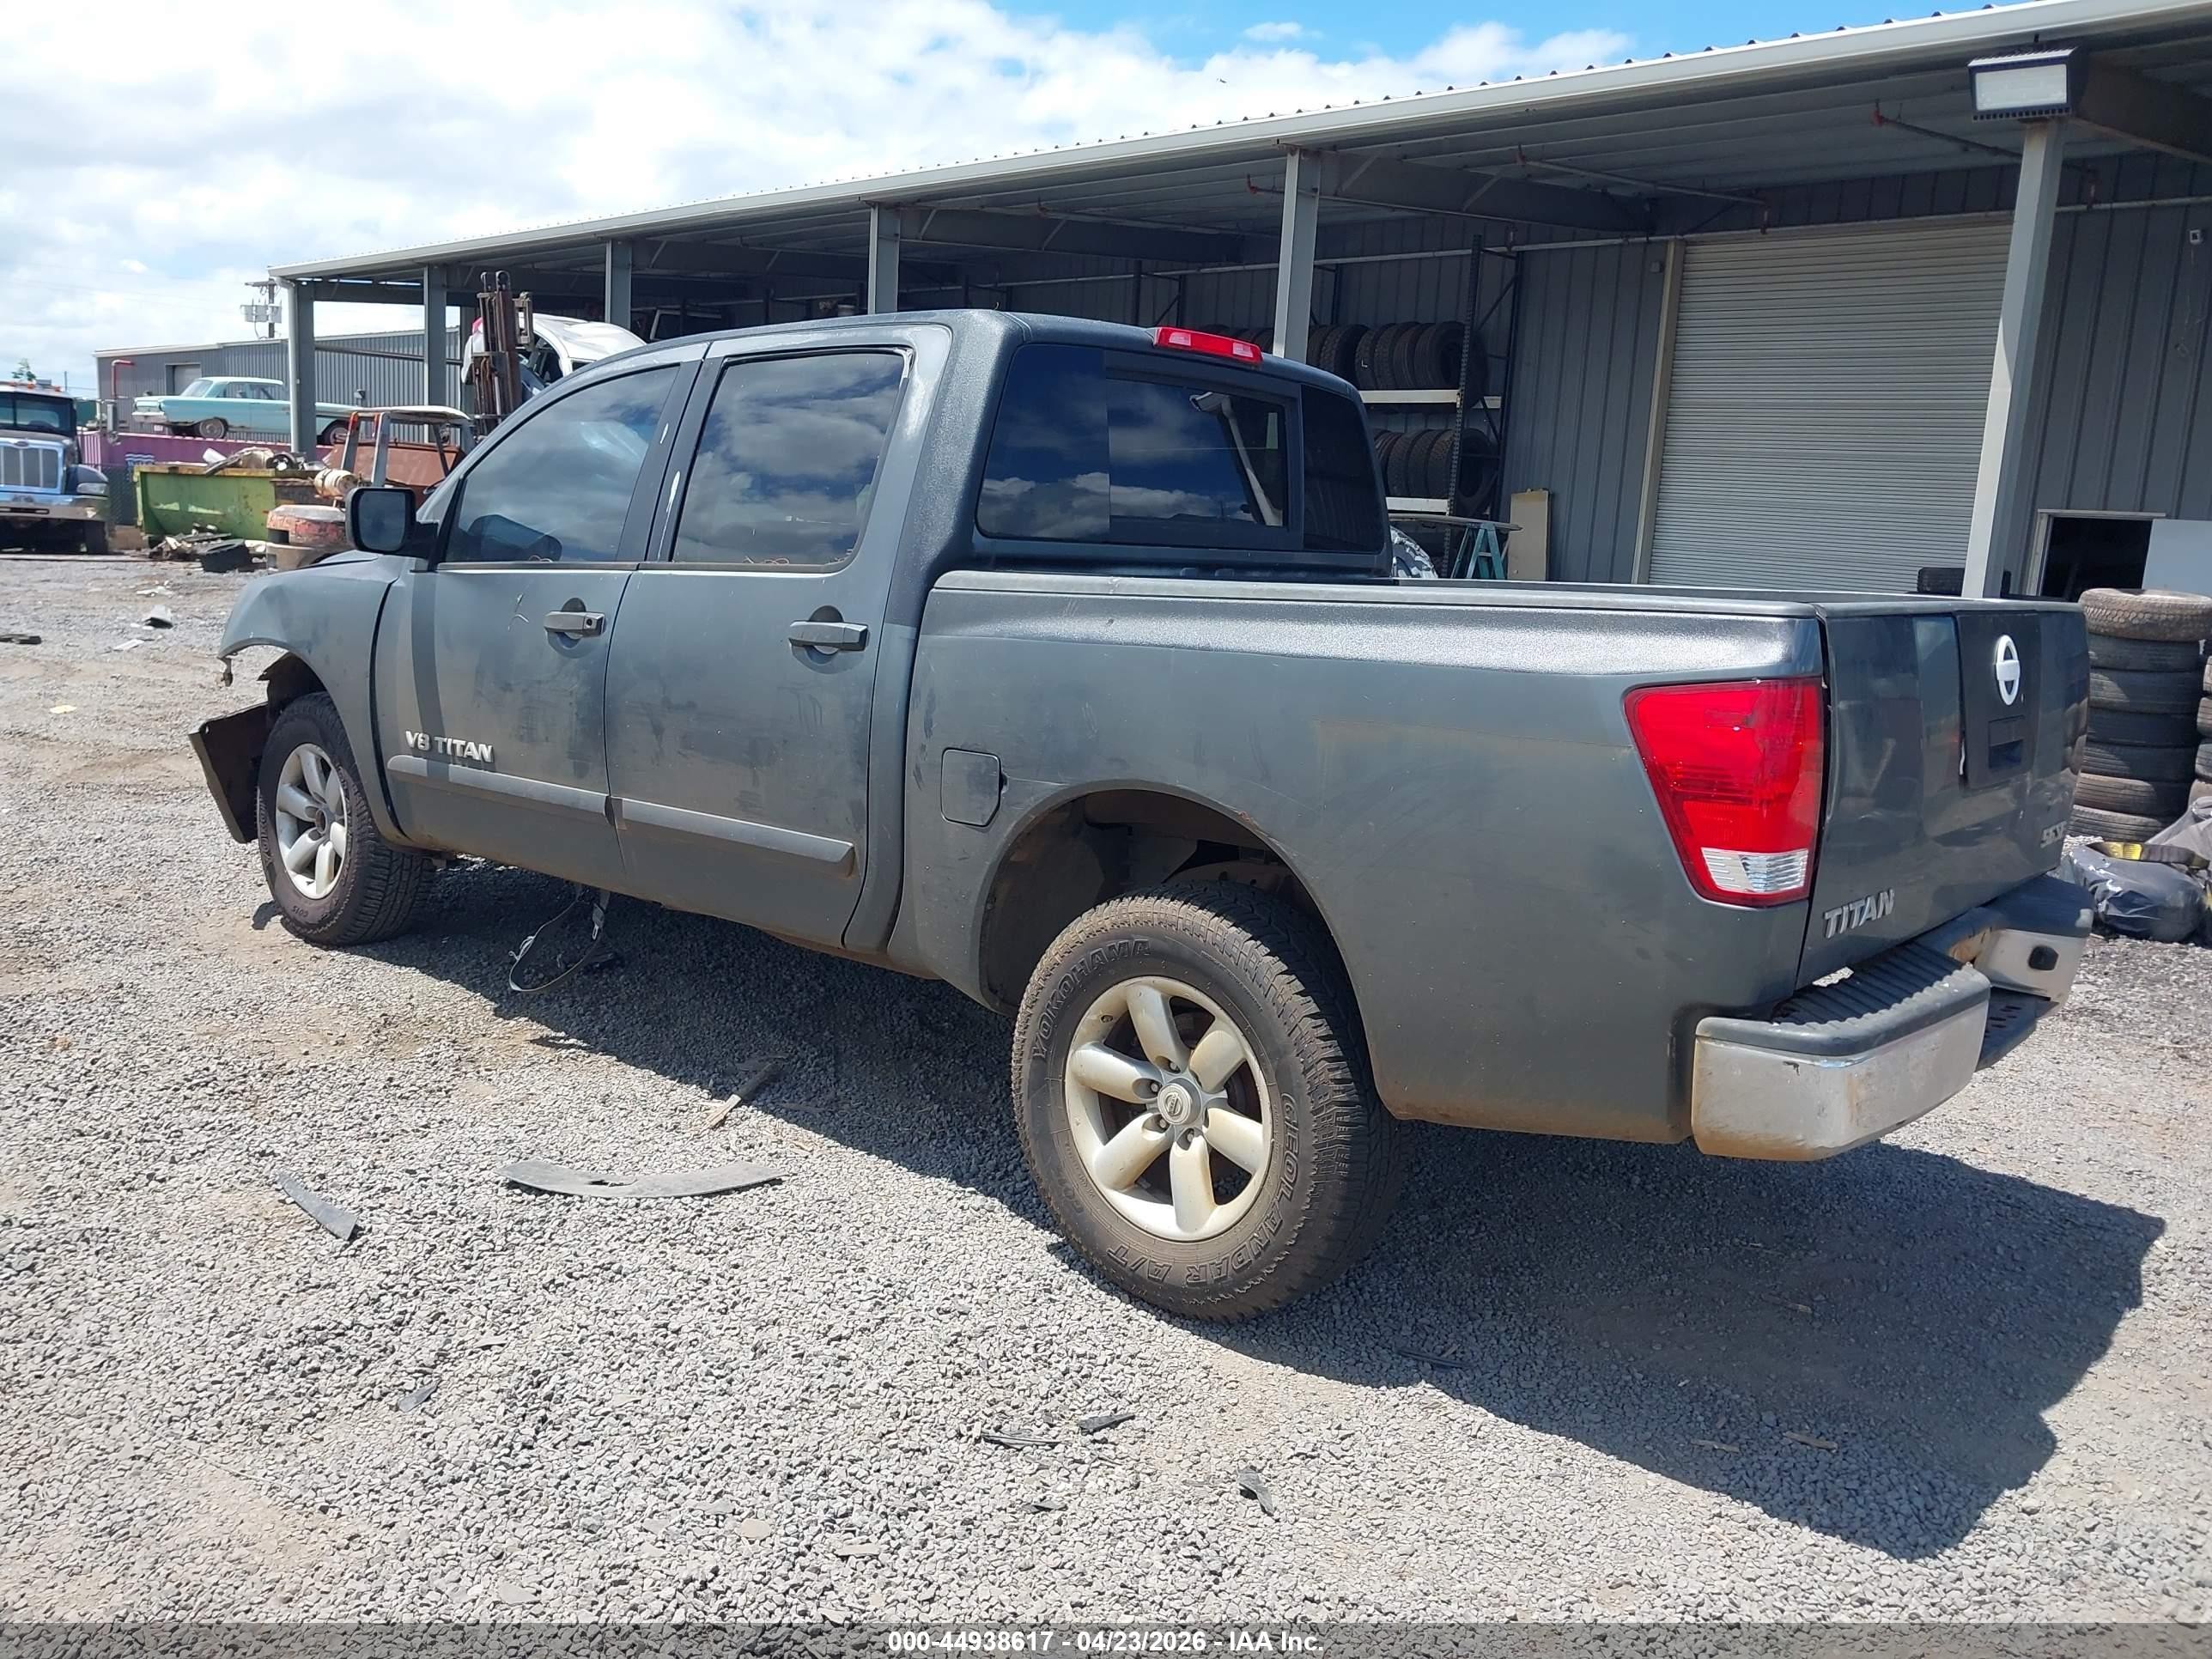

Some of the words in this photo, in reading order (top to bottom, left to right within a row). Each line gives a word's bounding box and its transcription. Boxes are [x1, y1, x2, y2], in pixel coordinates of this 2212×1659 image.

[405, 730, 431, 751] V8
[434, 736, 494, 763] TITAN
[1824, 888, 1895, 939] TITAN
[1031, 938, 1152, 1060] YOKOHAMA
[1186, 1092, 1300, 1285] GEOLANDAR
[1107, 1243, 1173, 1283] A/T
